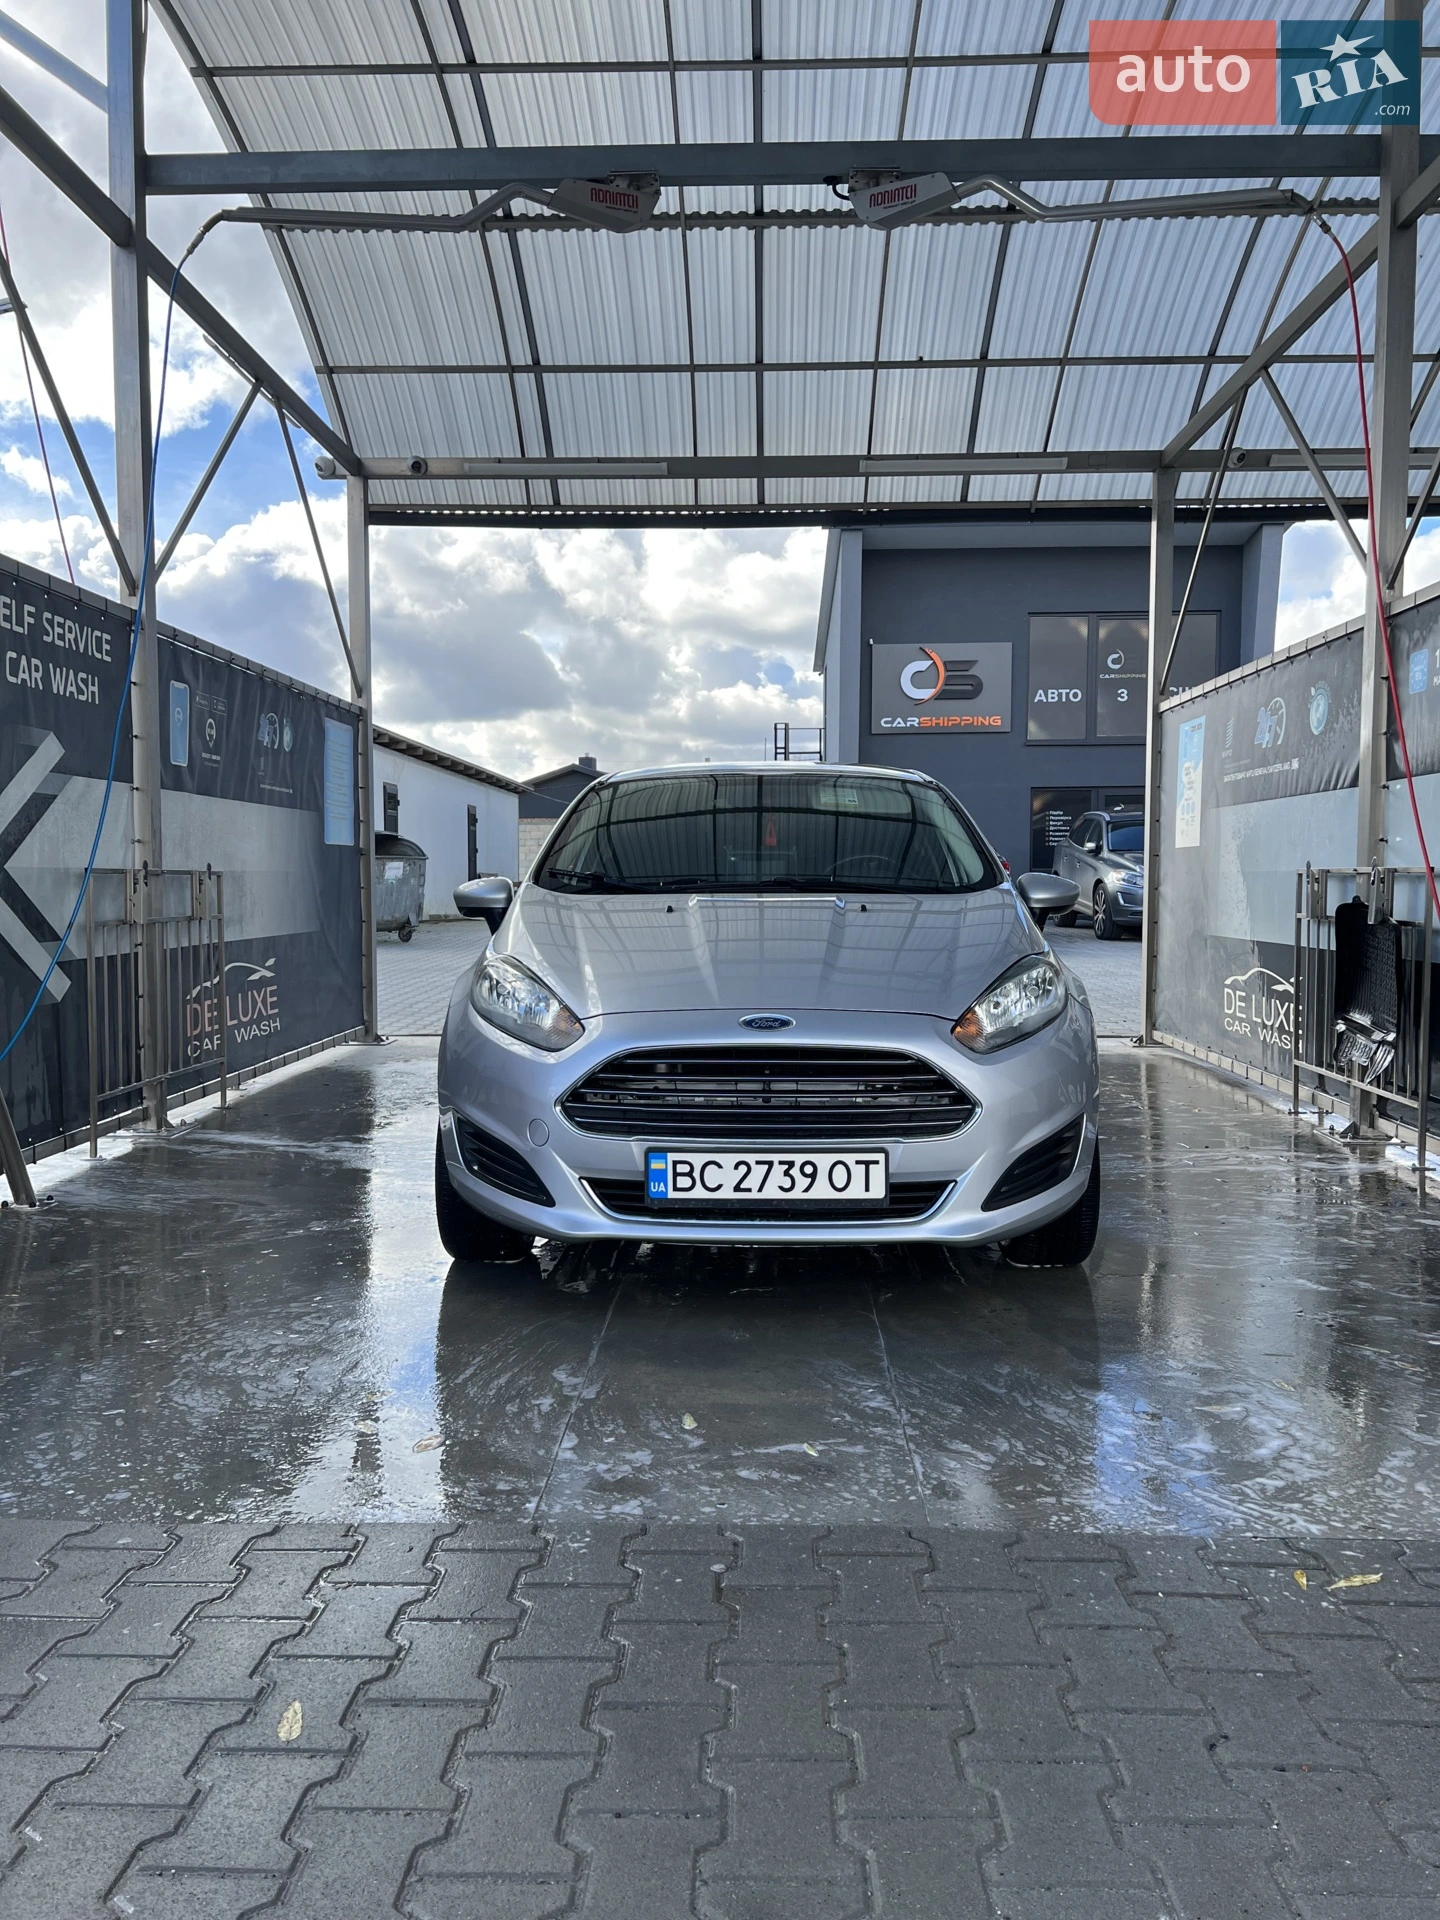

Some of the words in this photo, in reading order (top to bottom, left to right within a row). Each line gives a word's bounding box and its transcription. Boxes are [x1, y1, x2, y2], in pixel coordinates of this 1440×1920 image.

[0, 595, 36, 635] ELF
[42, 611, 112, 662] SERVICE
[6, 650, 43, 690] CAR
[49, 662, 99, 704] WASH
[1033, 688, 1083, 703] АВТО
[880, 716, 1002, 728] CARSHIPPING
[186, 998, 220, 1037] DE
[225, 985, 279, 1027] LUXE
[1224, 987, 1247, 1019] DE
[234, 1017, 281, 1043] WASH
[751, 1017, 782, 1028] Ford
[1224, 1017, 1252, 1038] CAR
[650, 1181, 667, 1193] UA
[671, 1159, 725, 1193] BC
[732, 1159, 819, 1194] 2739
[827, 1159, 881, 1193] OT
